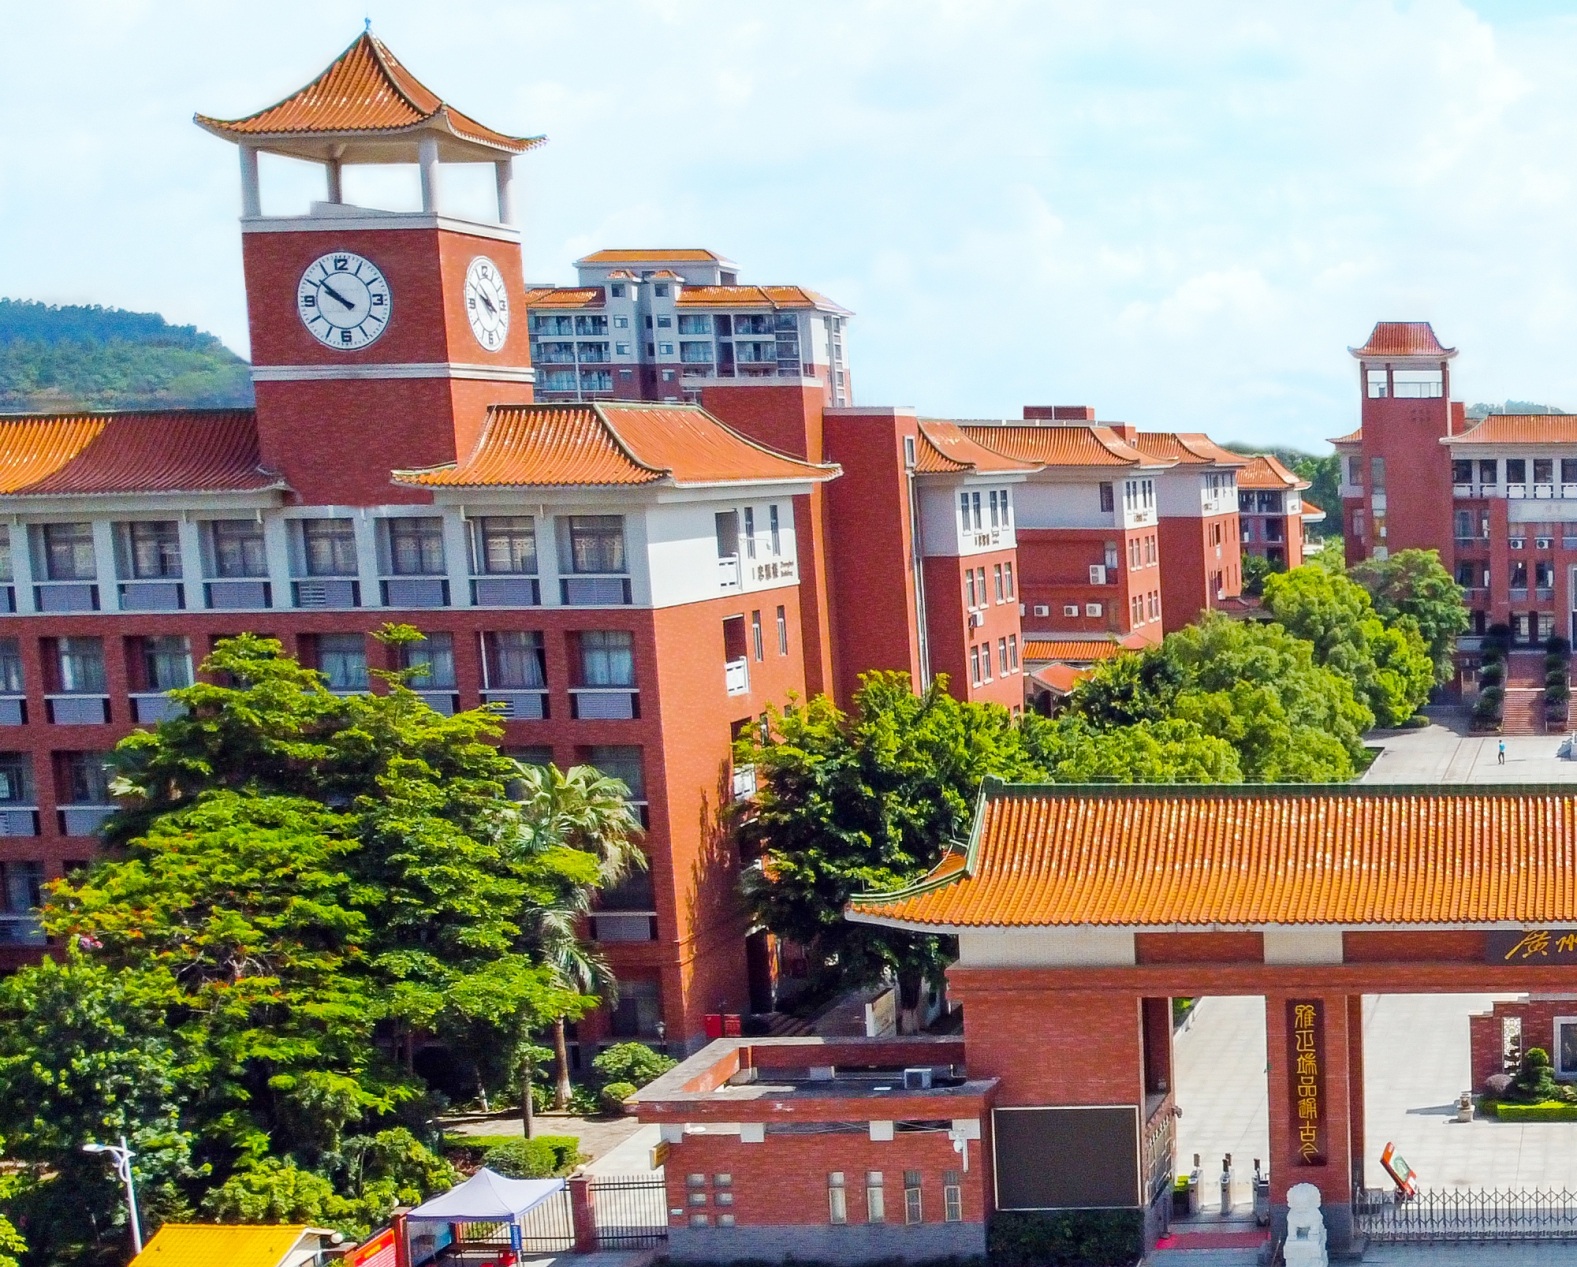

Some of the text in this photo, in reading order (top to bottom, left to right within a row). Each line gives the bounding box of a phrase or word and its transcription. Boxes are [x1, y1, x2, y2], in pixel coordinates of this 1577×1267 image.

[334, 258, 348, 270] 12
[304, 295, 315, 307] 9
[372, 293, 384, 305] 3
[341, 331, 352, 342] 6
